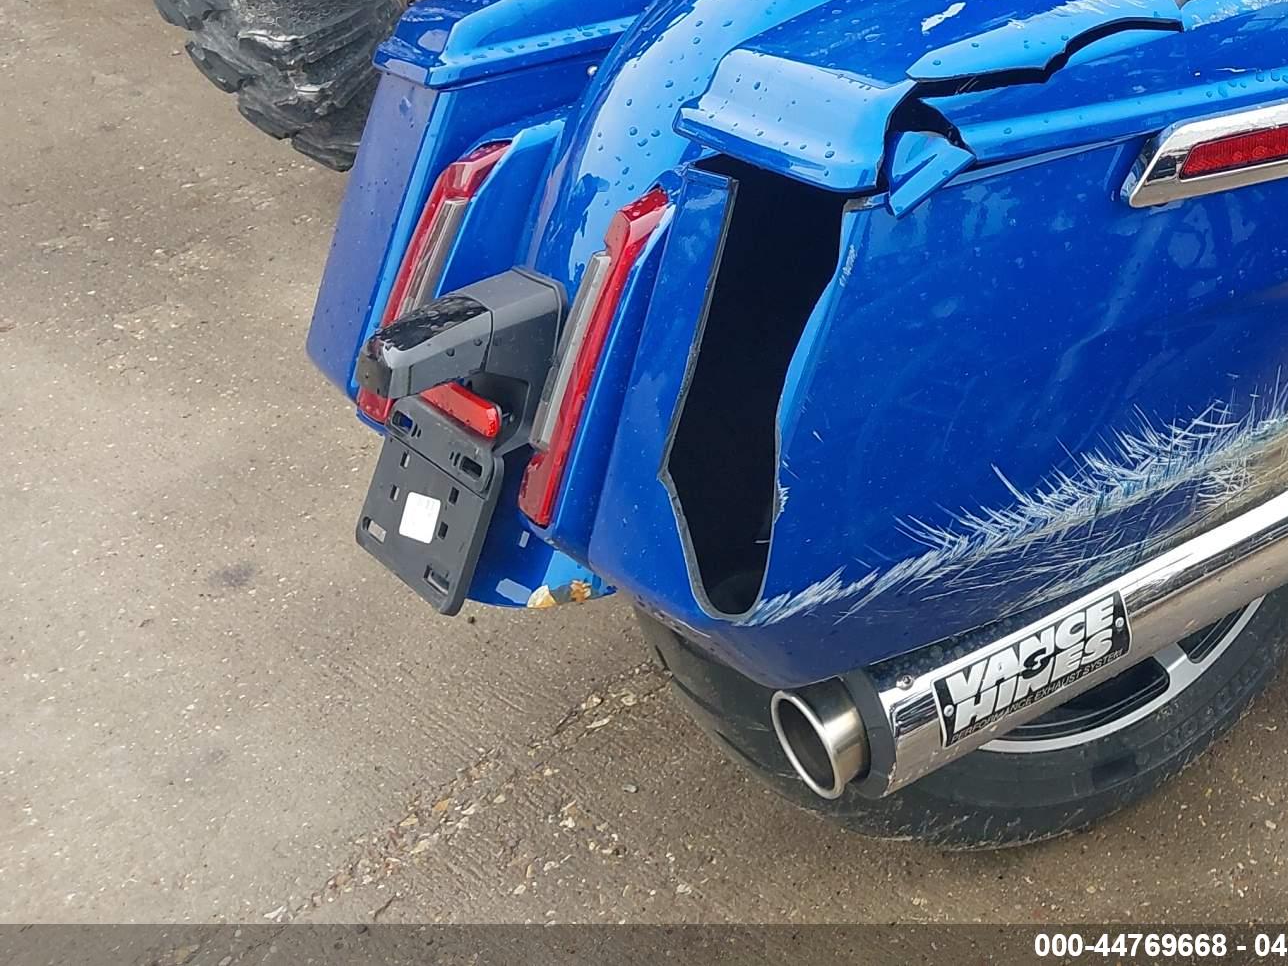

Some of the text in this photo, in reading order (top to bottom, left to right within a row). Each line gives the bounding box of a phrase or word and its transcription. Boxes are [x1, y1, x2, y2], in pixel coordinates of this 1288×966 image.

[945, 596, 1114, 704] VANCE
[953, 629, 1113, 734] HINES
[951, 695, 1034, 743] PERFORMANCE
[1034, 668, 1082, 700] EXHAUST
